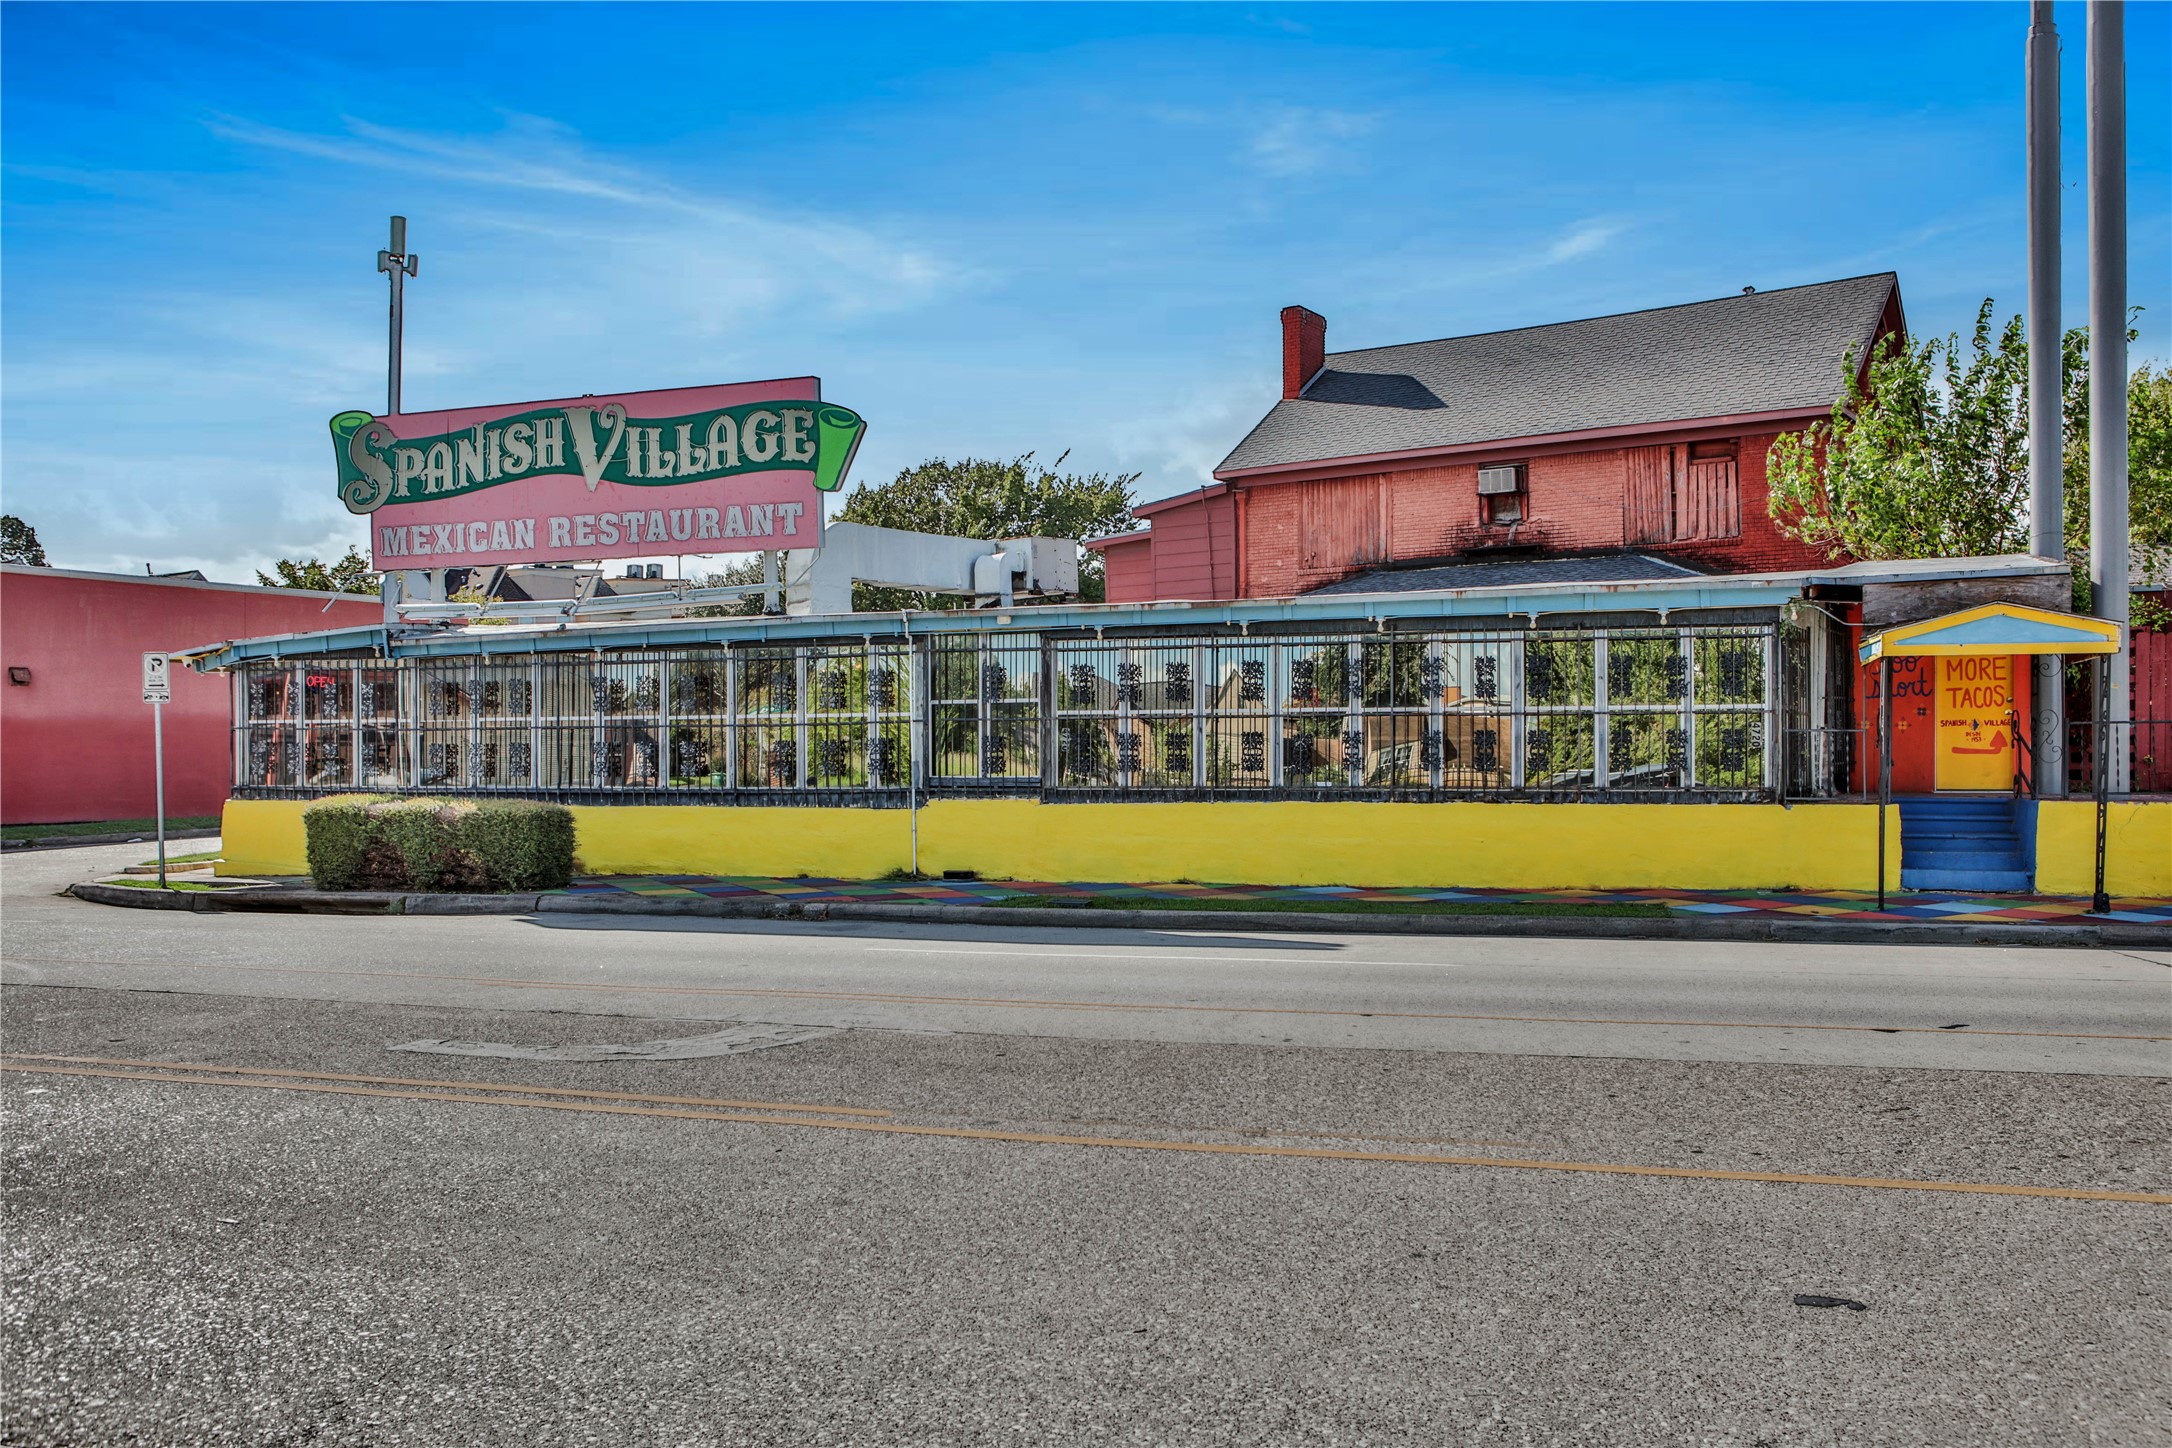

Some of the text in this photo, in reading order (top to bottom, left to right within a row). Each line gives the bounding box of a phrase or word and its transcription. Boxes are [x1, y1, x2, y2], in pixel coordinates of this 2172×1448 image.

[344, 403, 816, 514] SPANISH VILLAGE
[379, 502, 803, 557] MEXICAN RESTAURANT
[1946, 657, 2007, 681] MORE
[306, 675, 335, 688] OPEN
[1945, 685, 2005, 709] TACOS
[1751, 722, 1761, 748] 4720
[1940, 719, 2011, 727] SPANISH VILLAGE
